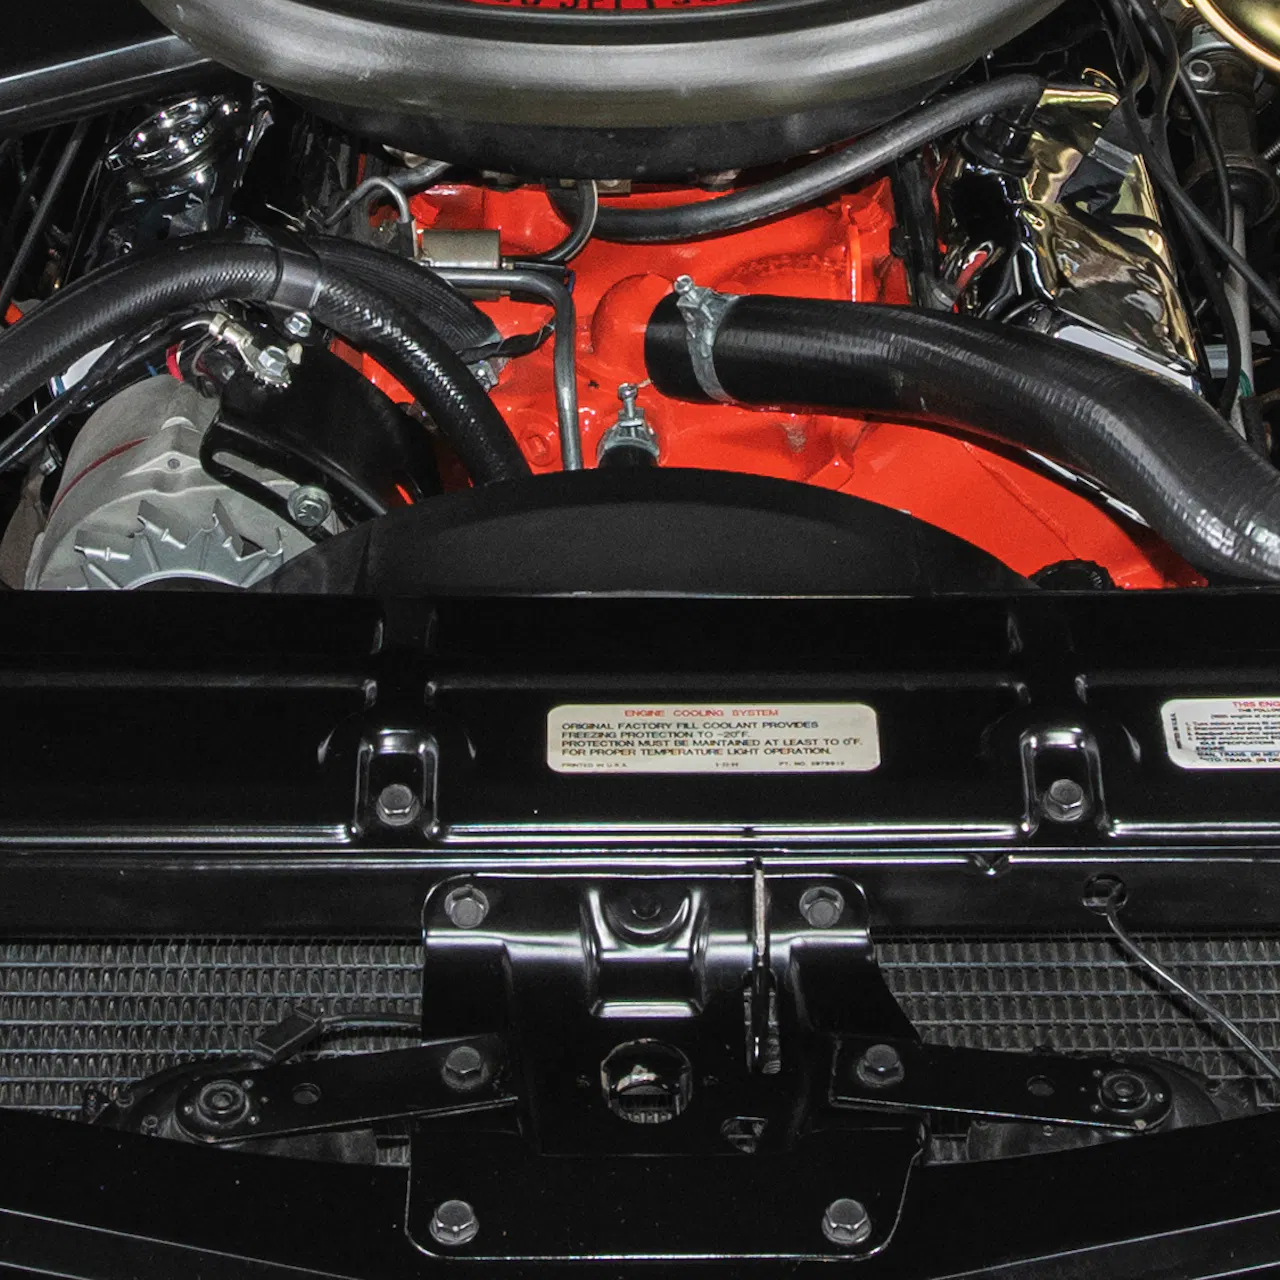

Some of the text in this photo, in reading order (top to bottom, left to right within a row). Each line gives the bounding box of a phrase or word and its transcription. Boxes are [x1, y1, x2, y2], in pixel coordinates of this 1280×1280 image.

[624, 709, 779, 717] ENGINE COOLING SYSTEM
[561, 722, 614, 730] ORIGINAL
[618, 722, 671, 730] FACTORY
[676, 722, 698, 730] FILL
[762, 721, 819, 729] PROVIDES
[561, 739, 634, 747] PROTECTION
[638, 739, 670, 747] MUST
[674, 739, 688, 747] BE
[823, 738, 839, 746] TO
[561, 748, 586, 756] FOR
[589, 748, 636, 756] PROPER
[640, 748, 723, 756] TEMPERATURE
